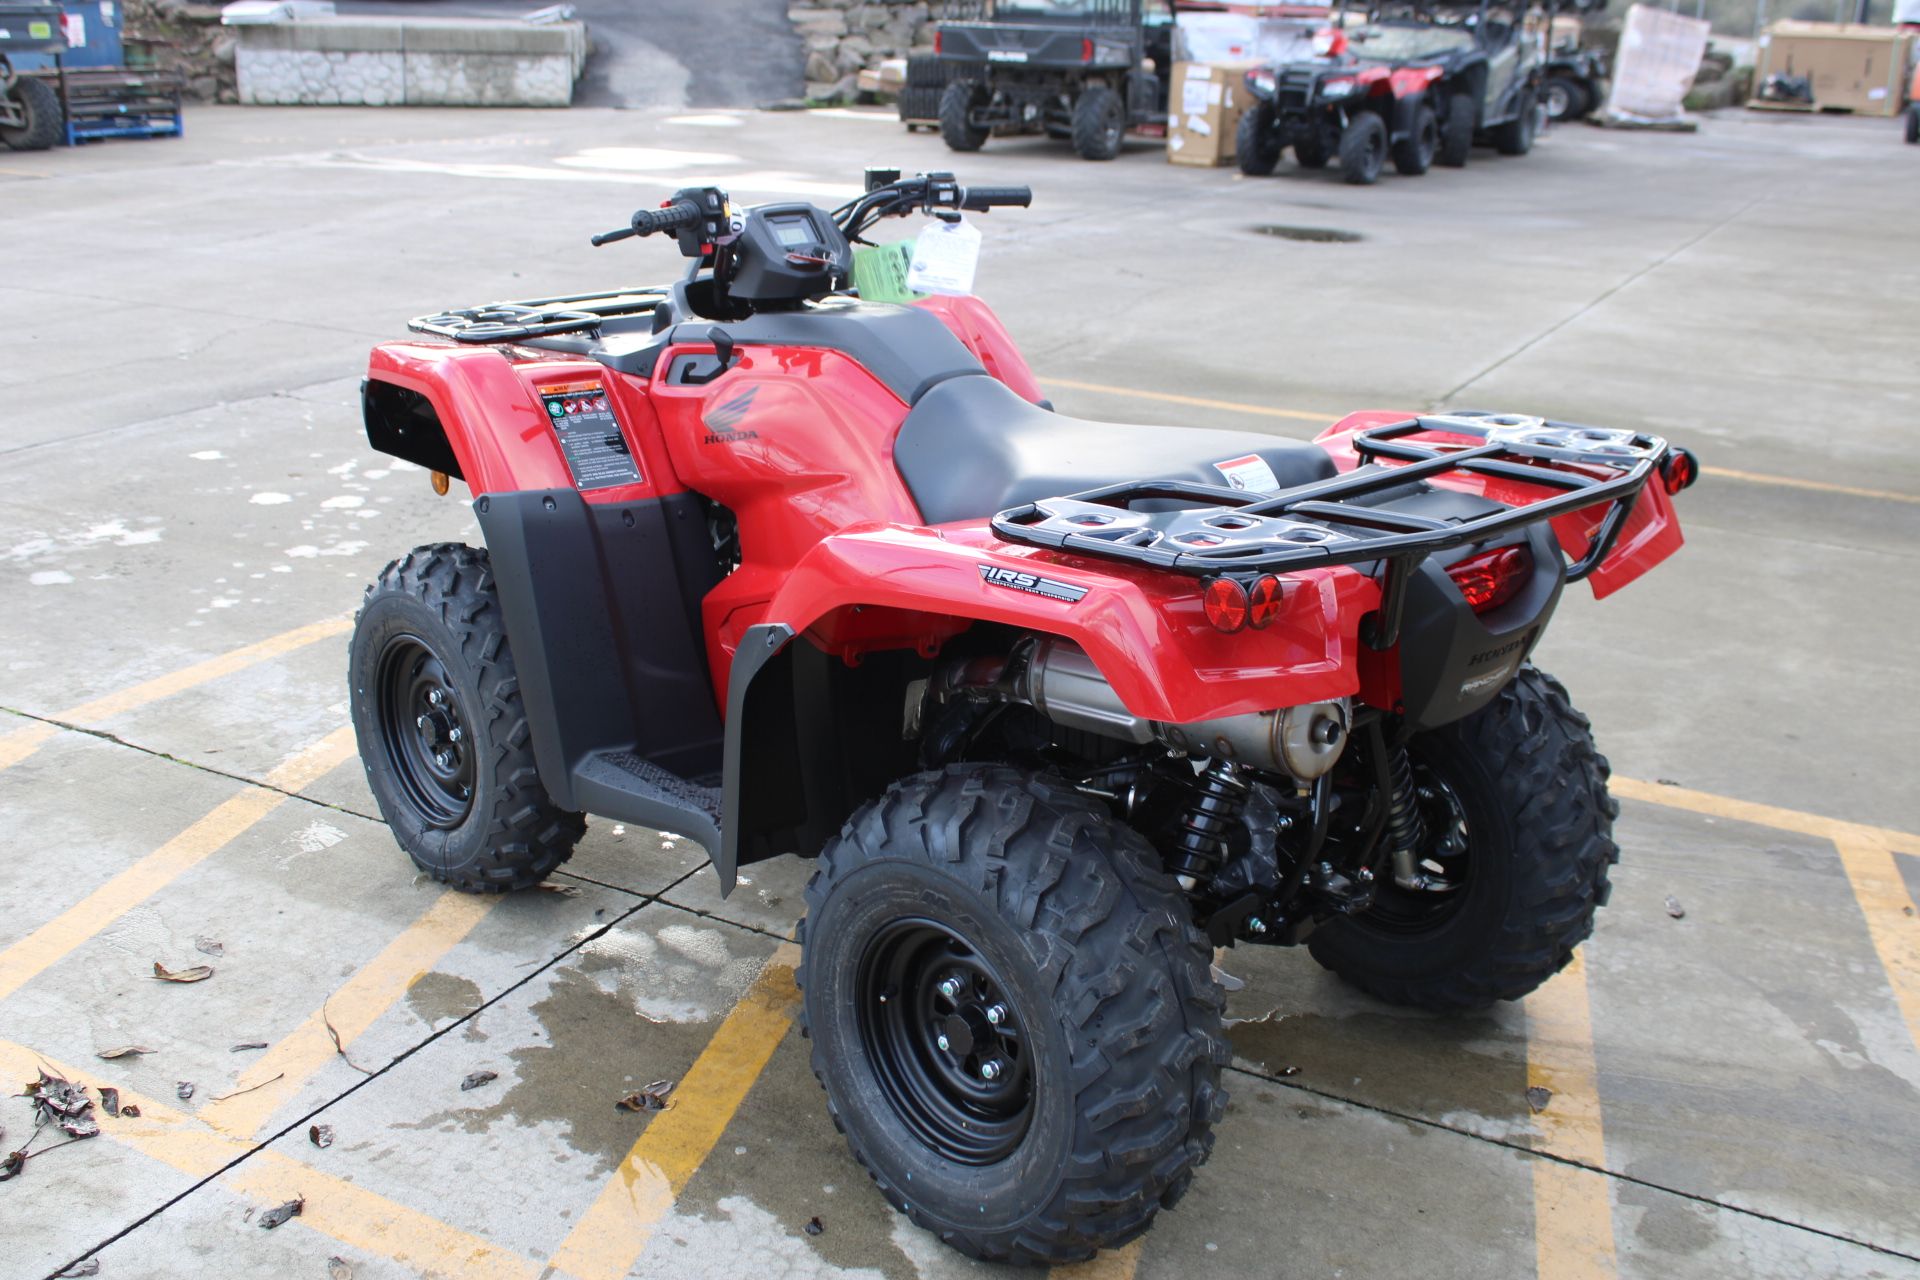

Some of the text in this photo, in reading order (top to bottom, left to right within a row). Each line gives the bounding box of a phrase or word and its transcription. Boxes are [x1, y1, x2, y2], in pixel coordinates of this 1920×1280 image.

[704, 430, 758, 445] HONDA
[987, 567, 1037, 587] IRS
[1040, 591, 1075, 602] SUSPENSION
[1468, 636, 1526, 666] HONDA
